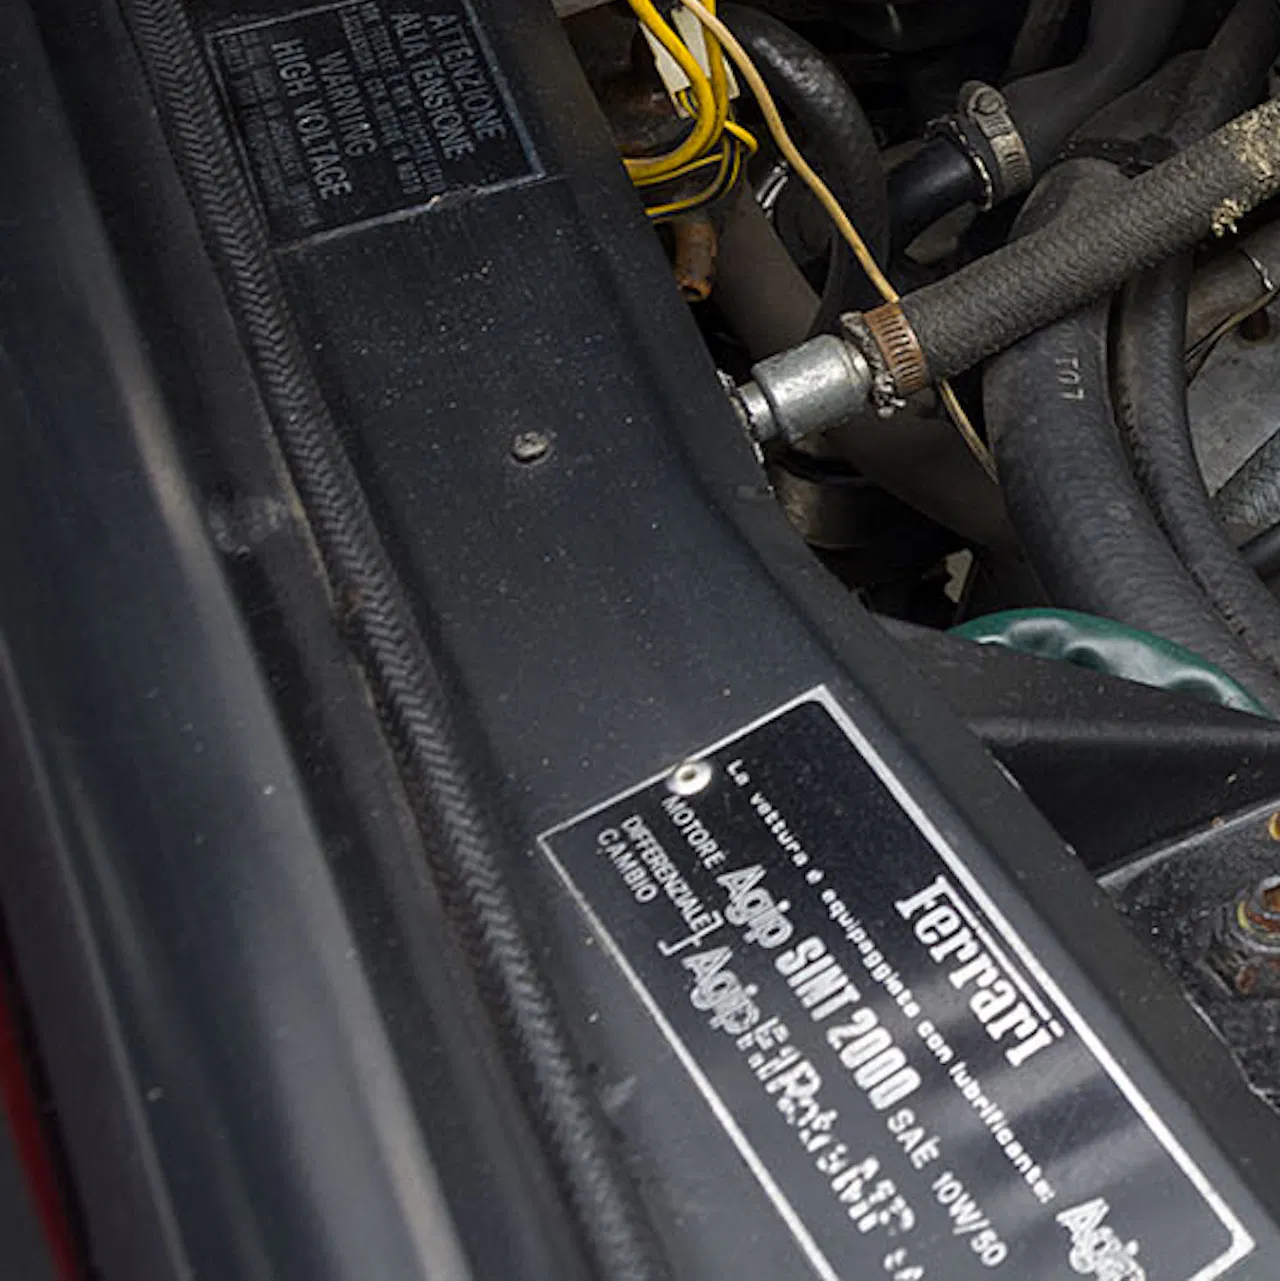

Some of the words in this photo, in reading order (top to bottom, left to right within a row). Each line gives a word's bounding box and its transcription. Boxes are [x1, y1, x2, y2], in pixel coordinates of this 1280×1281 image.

[270, 38, 317, 101] HIGH
[316, 49, 378, 158] WARNING
[390, 11, 427, 58] ALTA
[410, 54, 475, 160] TENSIONE
[427, 13, 507, 141] ATTENZIONE
[293, 98, 352, 200] VOLTAGE
[597, 827, 657, 904] CAMBIO
[620, 813, 712, 932] DIFFERENZIALE
[725, 758, 750, 788] La
[749, 790, 809, 868] vettura
[916, 1019, 954, 1064] con
[681, 945, 760, 1035] Agip
[894, 873, 1065, 1068] Ferrari
[661, 794, 727, 870] MOTORE
[716, 863, 794, 949] Agip
[774, 935, 862, 1022] SINT
[826, 1007, 922, 1111] 2000
[887, 1107, 942, 1171] SAE
[931, 1170, 1008, 1268] 10W/50
